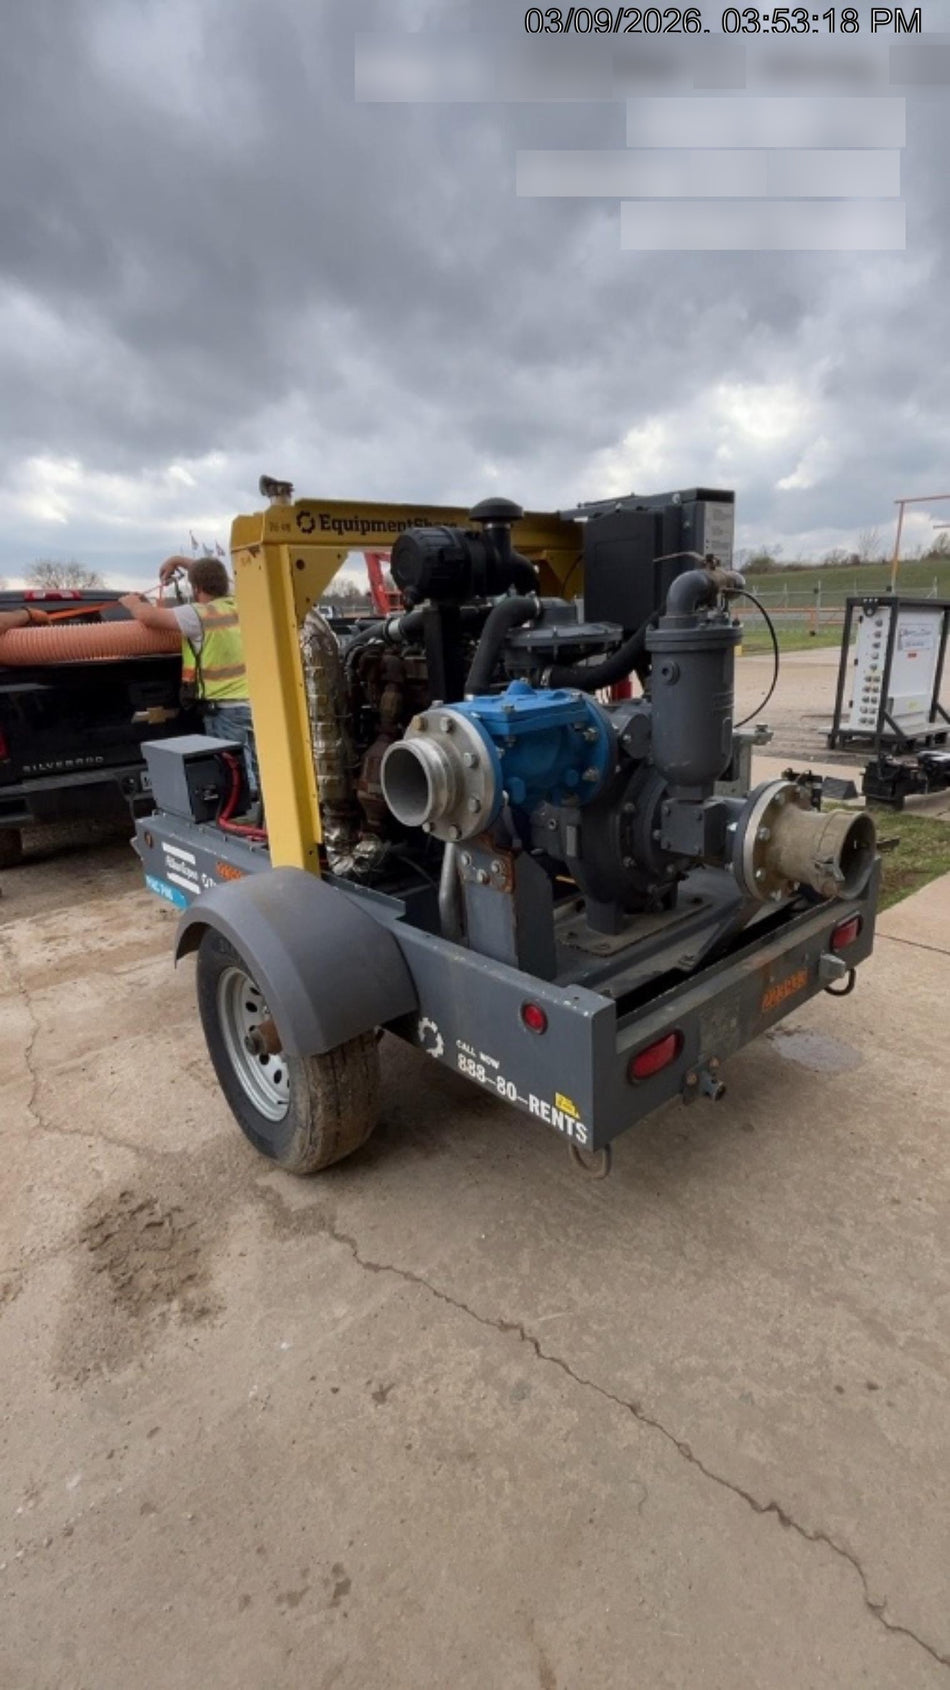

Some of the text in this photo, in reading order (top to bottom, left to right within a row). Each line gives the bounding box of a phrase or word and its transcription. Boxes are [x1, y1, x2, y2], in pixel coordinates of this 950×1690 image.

[456, 1039, 500, 1069] CALL NOW
[457, 1052, 588, 1144] 888-80-RENTS
